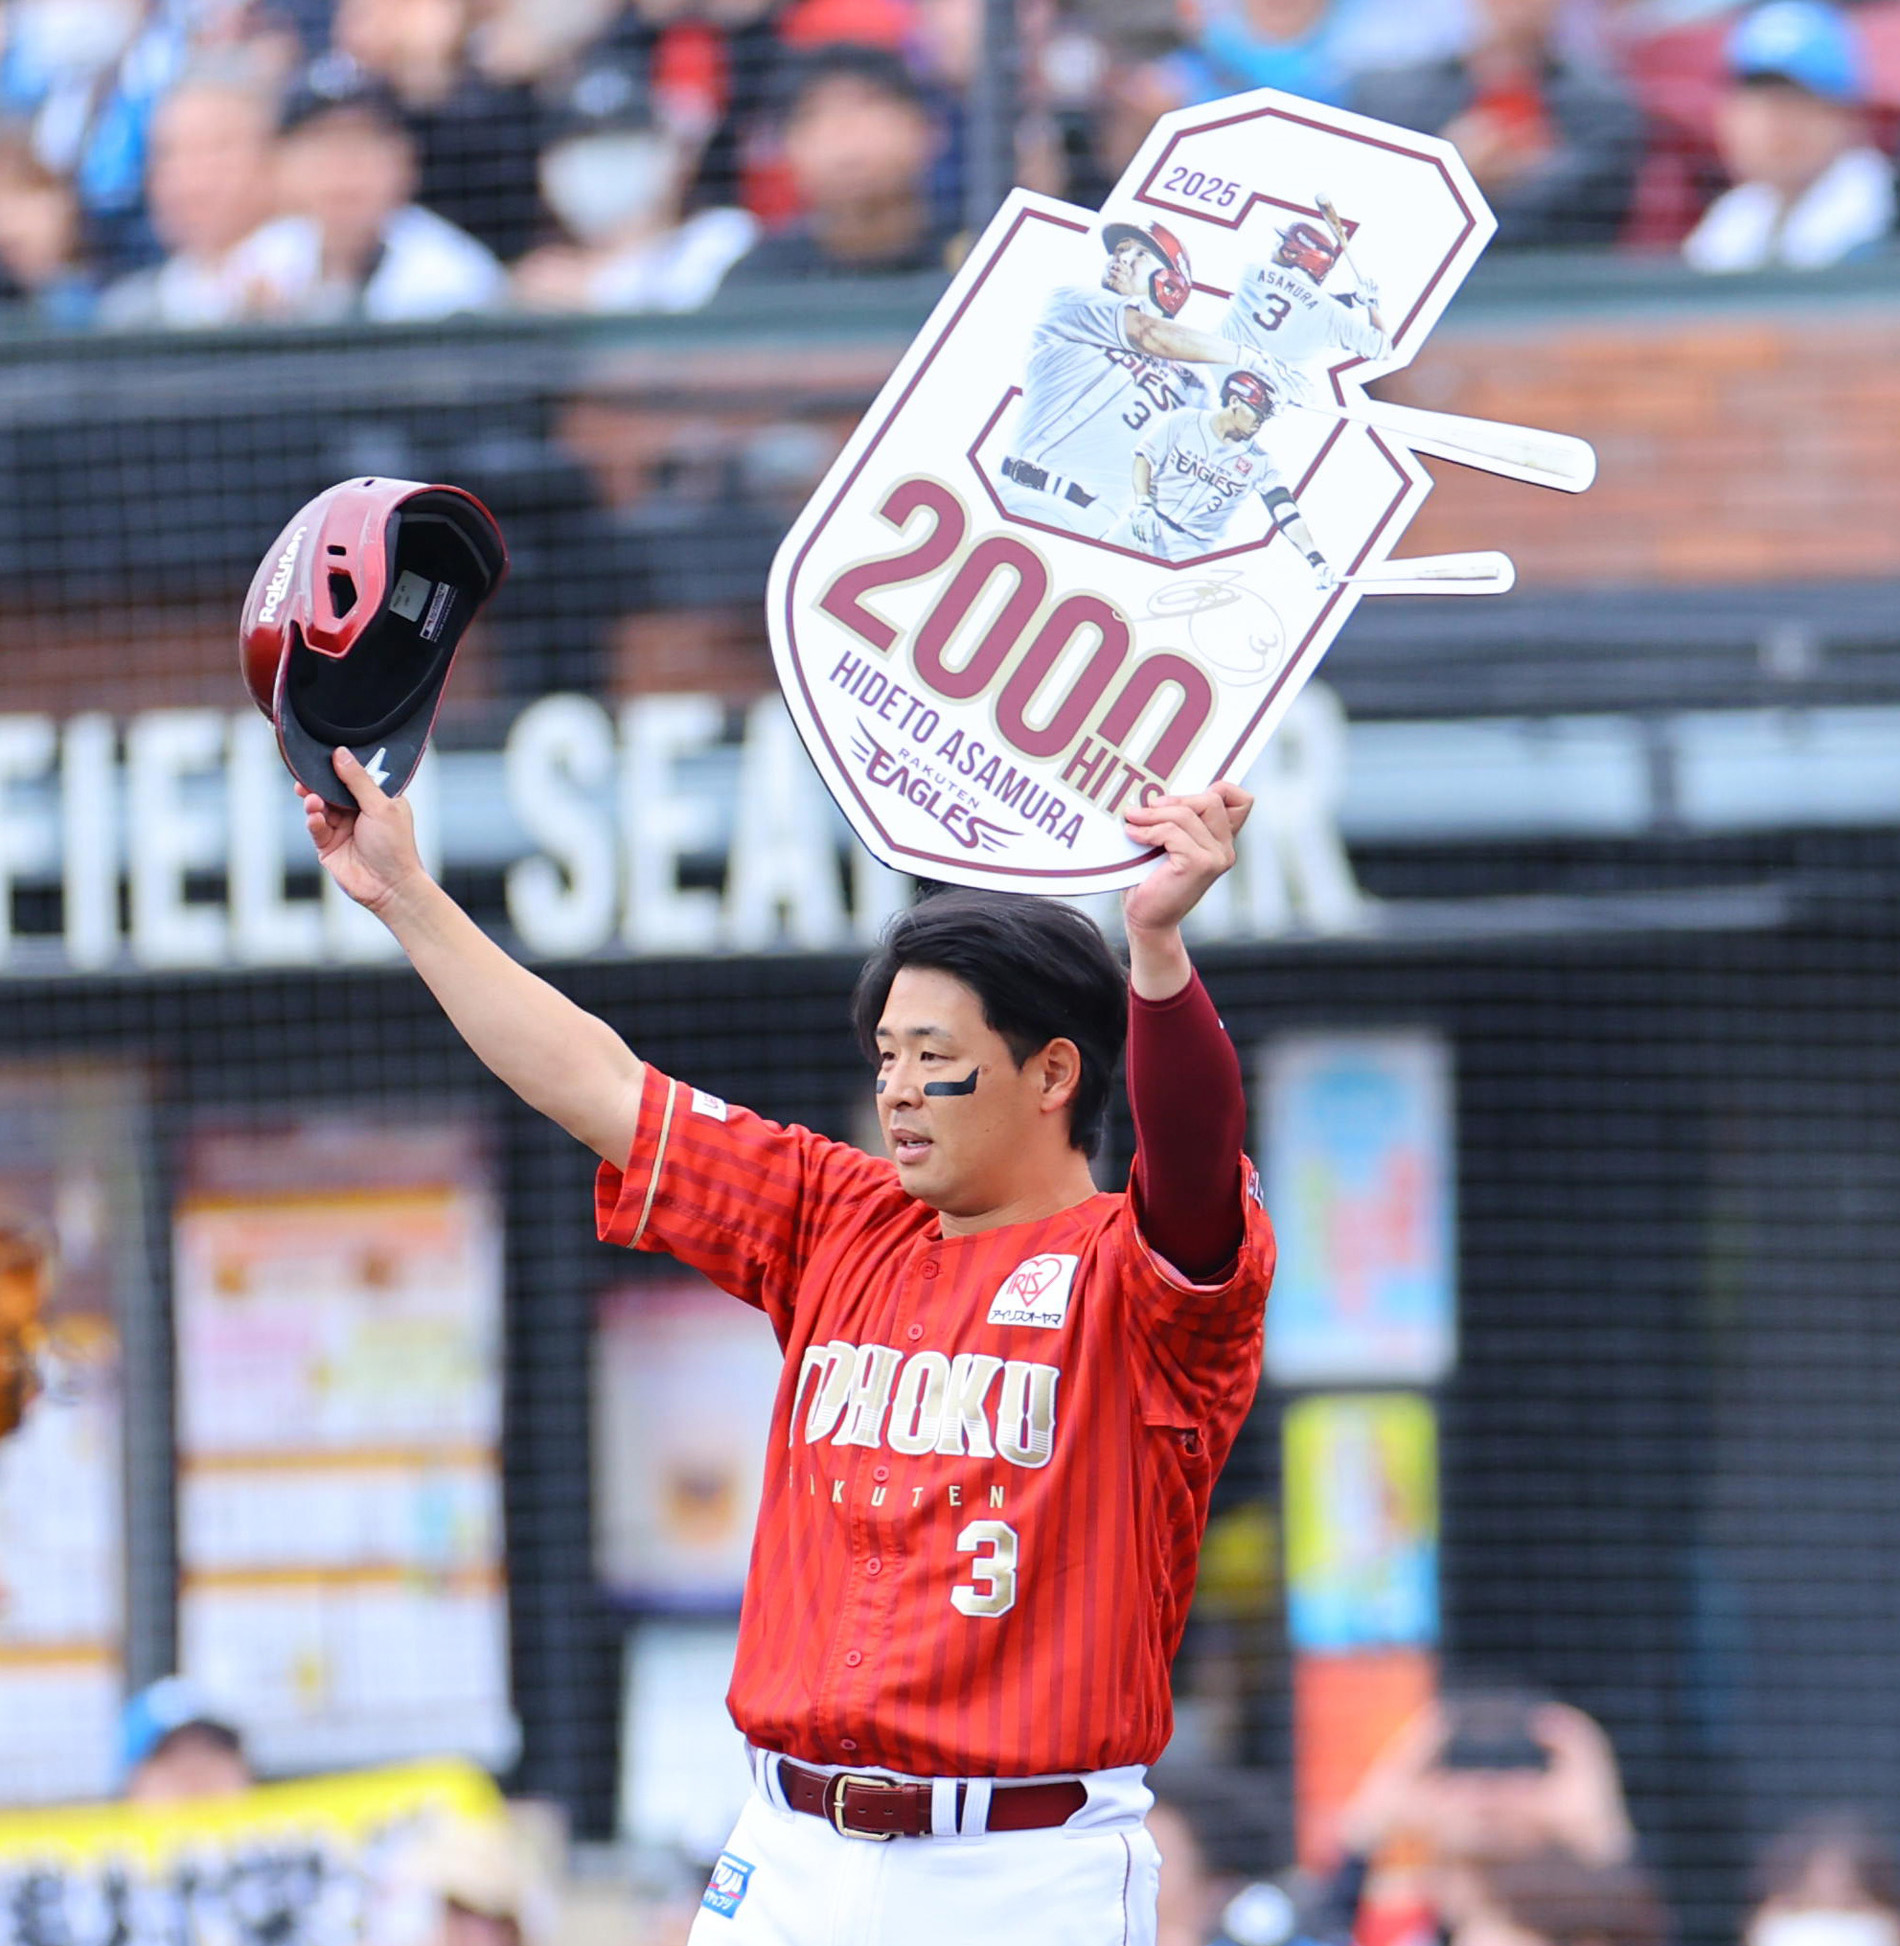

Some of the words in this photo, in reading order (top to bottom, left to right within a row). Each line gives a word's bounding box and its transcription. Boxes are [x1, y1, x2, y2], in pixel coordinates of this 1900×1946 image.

[1163, 166, 1241, 207] 2025
[1252, 293, 1292, 331] 3
[1257, 269, 1320, 311] ASAMURA
[1122, 400, 1151, 430] 3
[1173, 446, 1247, 498] EAGLES
[1206, 495, 1223, 513] 3
[258, 525, 308, 624] Rakuten
[814, 475, 1217, 782] 2000
[828, 649, 940, 744] HIDETO
[935, 728, 1085, 850] ASAMURA
[854, 715, 1024, 850] EAGLES
[897, 746, 981, 809] RAKUTEN
[0, 707, 445, 970] FIEL
[1006, 1271, 1044, 1295] IRIS
[989, 1309, 1062, 1325] アイリスオーヤマ
[789, 1464, 1006, 1510] KUTEN
[950, 1519, 1019, 1619] 3
